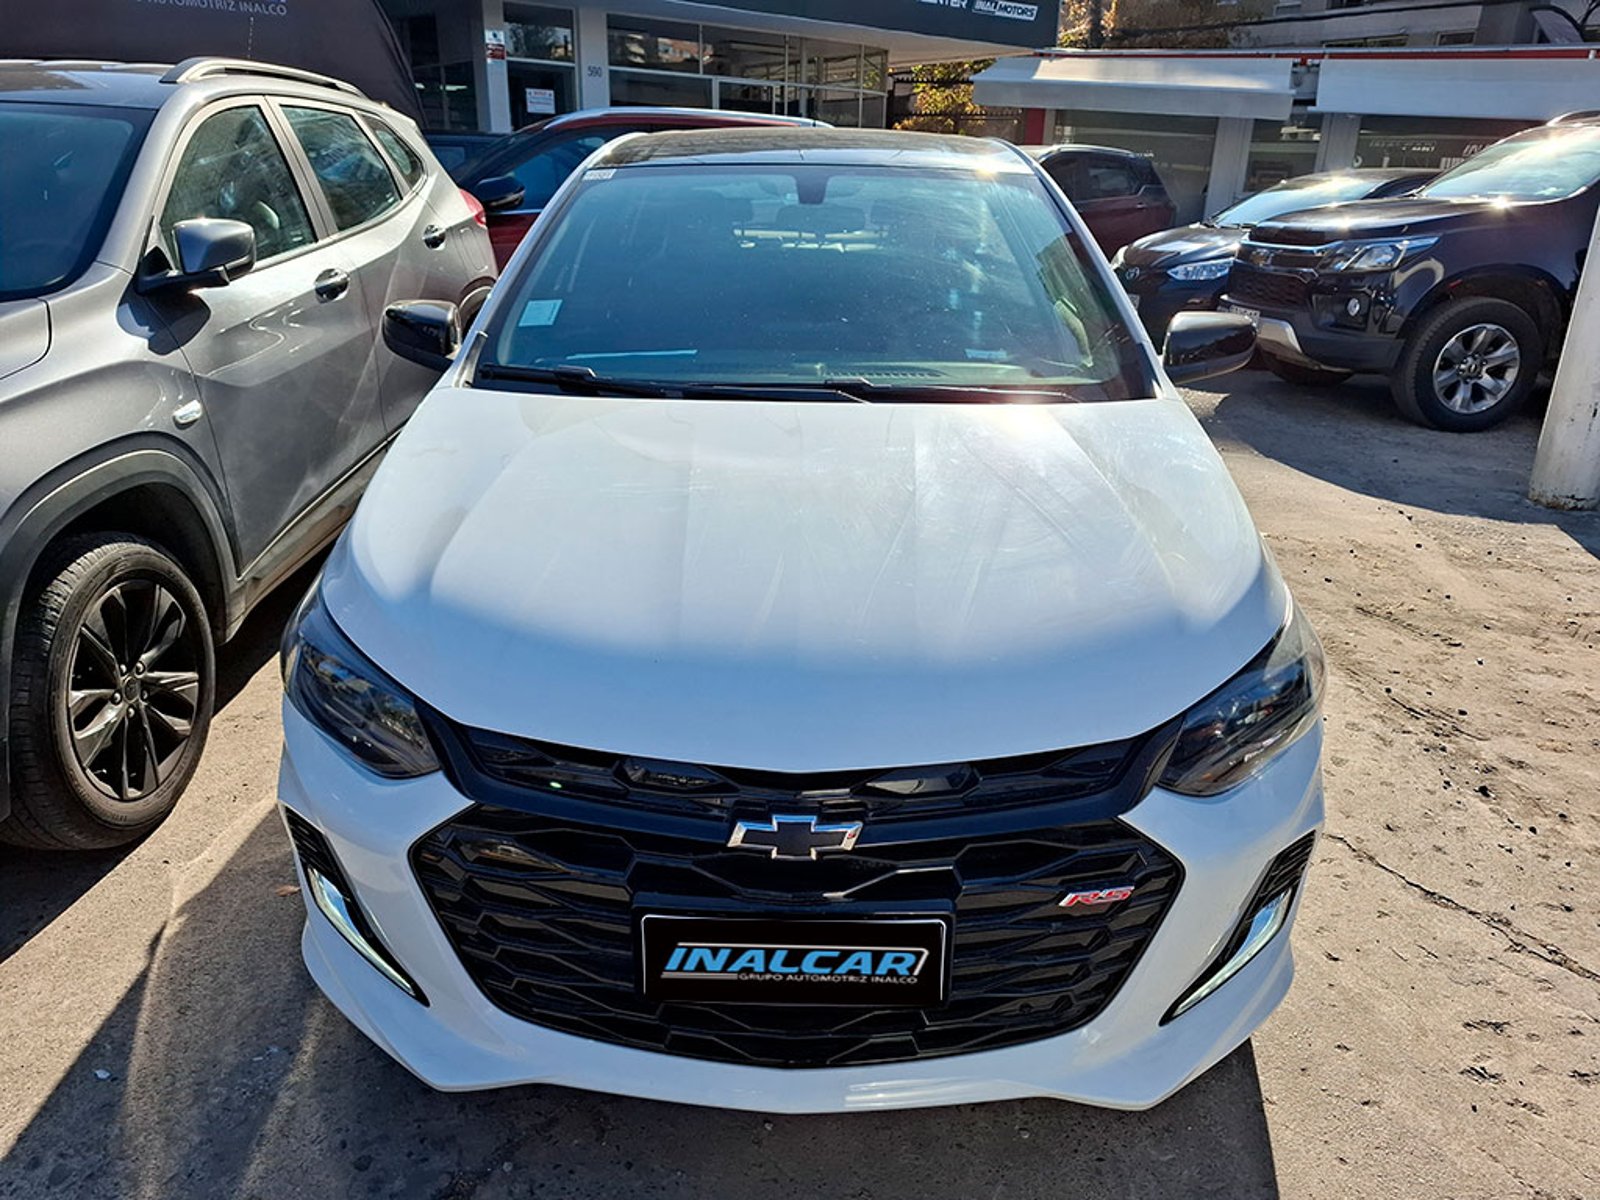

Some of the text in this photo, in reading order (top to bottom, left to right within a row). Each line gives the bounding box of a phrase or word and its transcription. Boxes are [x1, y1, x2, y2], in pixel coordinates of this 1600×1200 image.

[148, 0, 287, 16] UTOMOTRIZ INALCO
[1058, 885, 1135, 907] RS
[664, 947, 917, 976] INALCAR
[738, 973, 918, 985] GRUPO AUTOMOTRIZ INALCO
